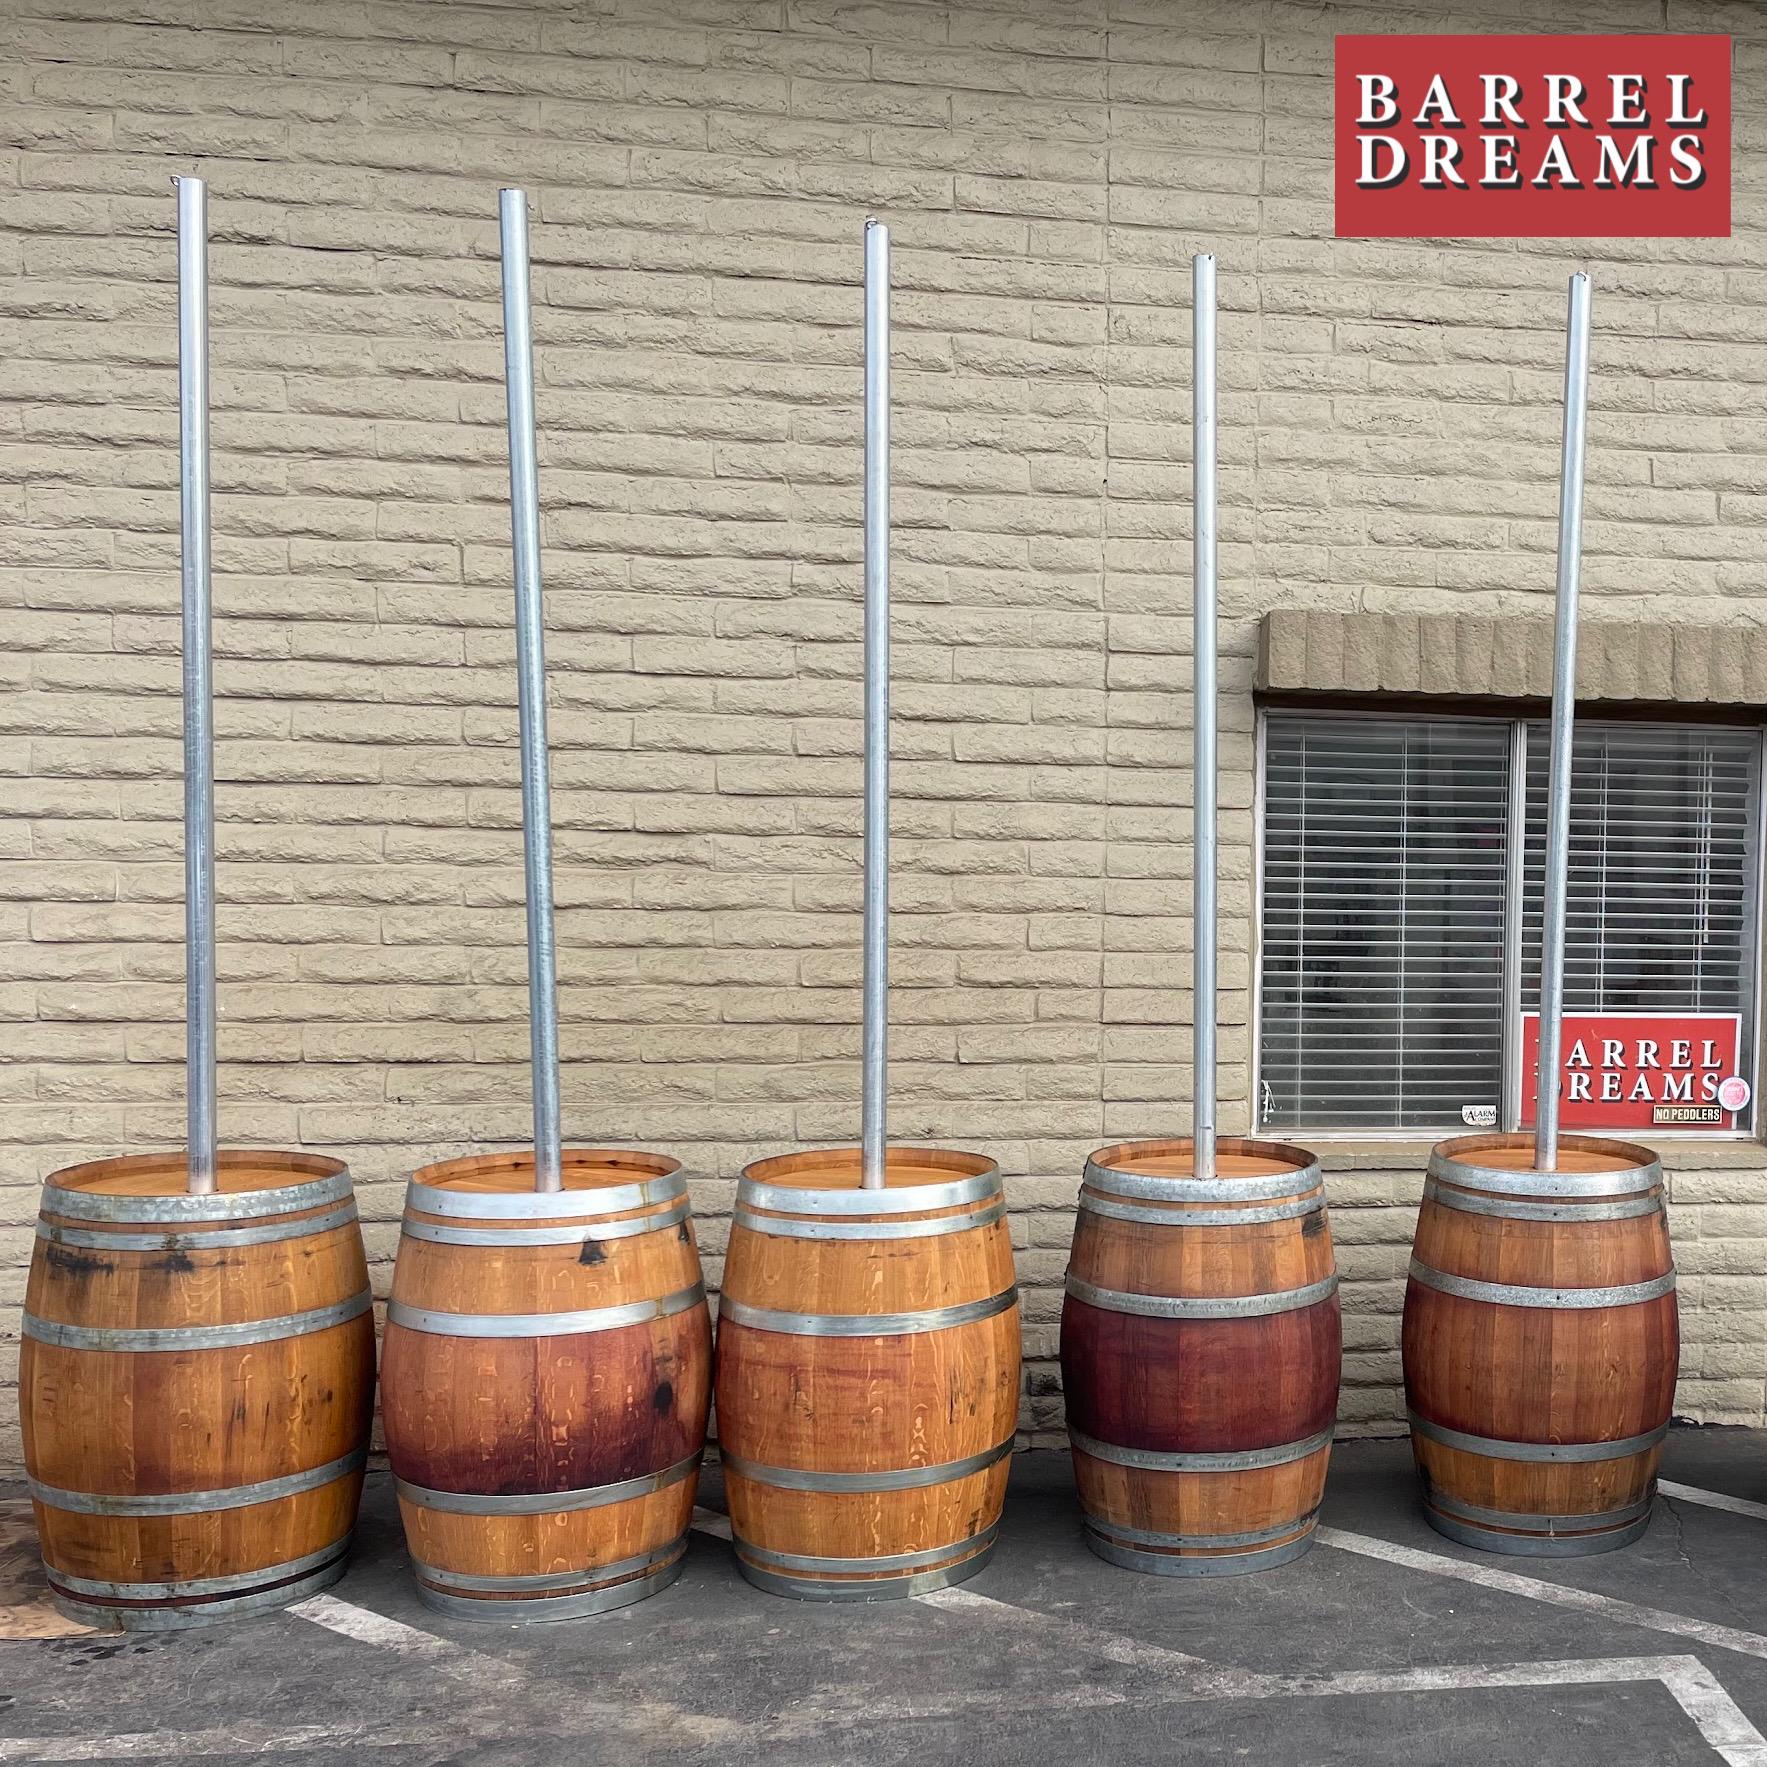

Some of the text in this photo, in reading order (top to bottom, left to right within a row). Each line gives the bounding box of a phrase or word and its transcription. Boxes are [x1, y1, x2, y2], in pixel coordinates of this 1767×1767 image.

[1535, 1038, 1723, 1070] ARREL
[1533, 1072, 1720, 1103] REAMS
[1466, 1110, 1496, 1121] ALARM
[1656, 1108, 1720, 1121] NO PEDDLERS
